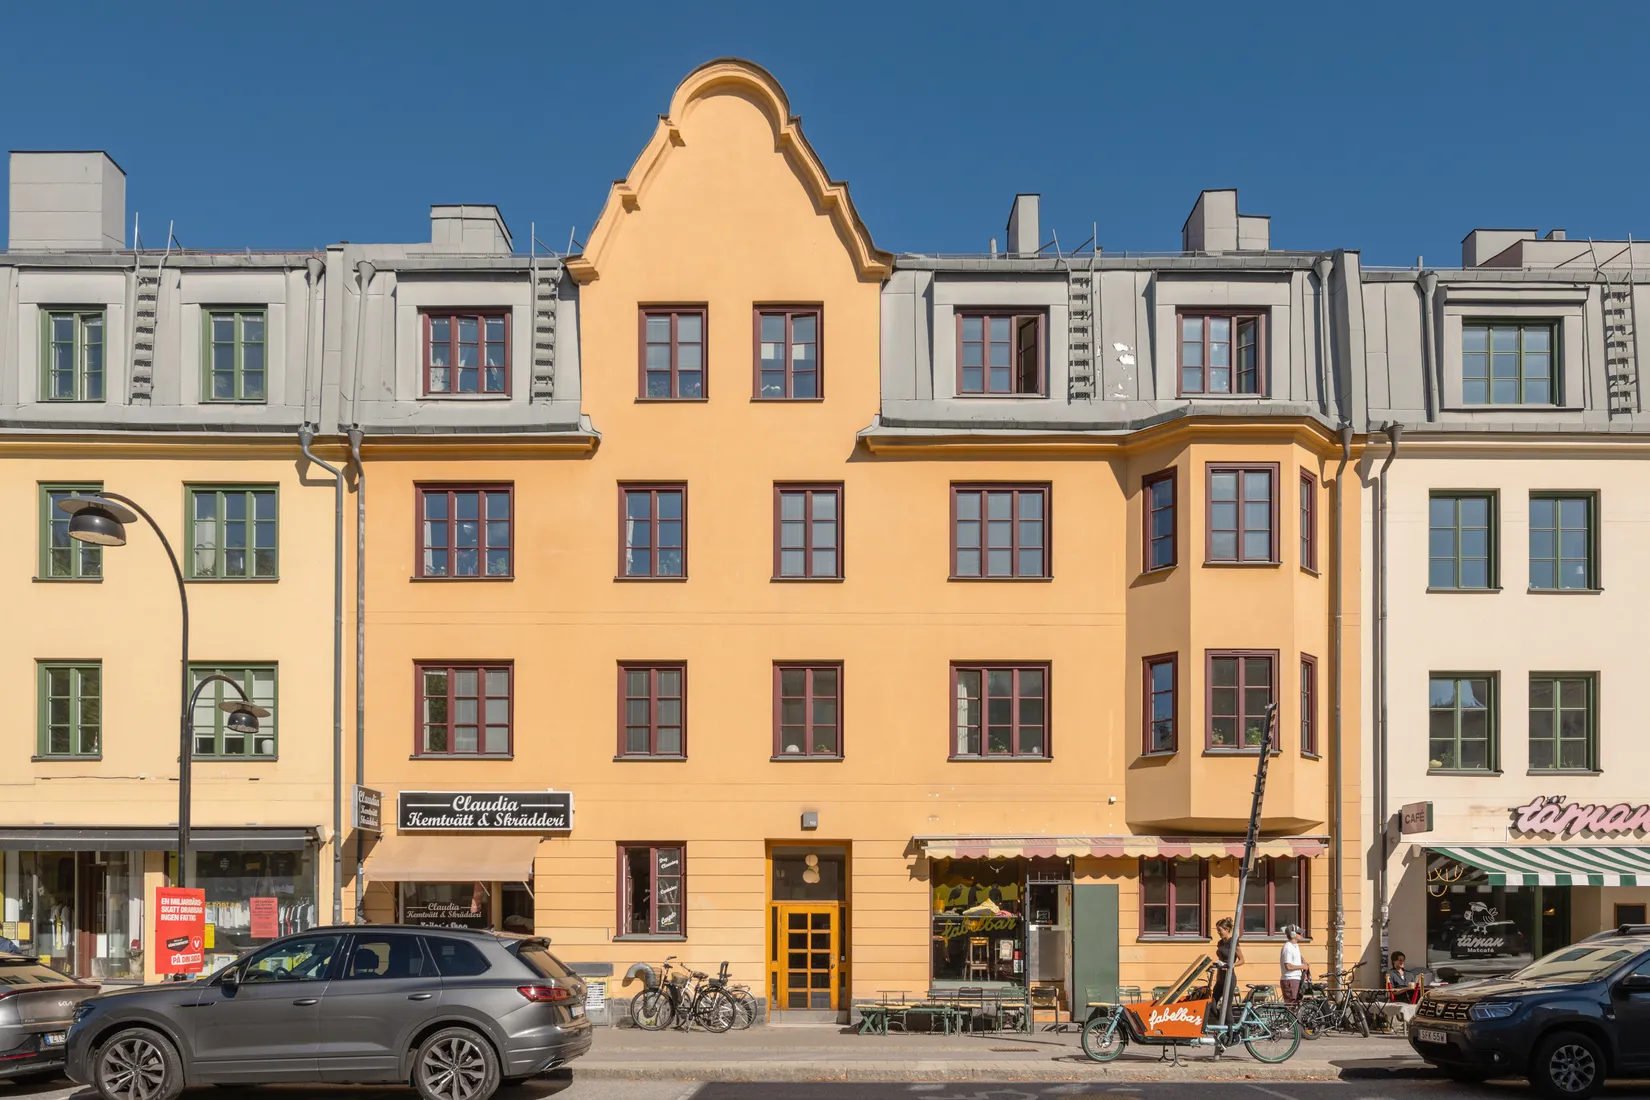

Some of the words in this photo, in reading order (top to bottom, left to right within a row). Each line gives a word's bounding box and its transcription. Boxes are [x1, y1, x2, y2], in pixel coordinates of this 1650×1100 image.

[358, 790, 380, 807] Claudia
[452, 795, 519, 812] Claudia
[406, 812, 474, 827] Kemtvätt
[477, 812, 490, 827] &
[493, 812, 565, 827] Skrädderi
[1405, 809, 1425, 824] CAFÉ
[161, 897, 170, 905] EN
[161, 905, 180, 913] SKATT
[427, 902, 460, 911] Claudia
[160, 913, 180, 921] INGEN
[448, 910, 482, 918] Skrädderi
[172, 955, 181, 964] PÅ
[1148, 1007, 1203, 1030] fabelbar
